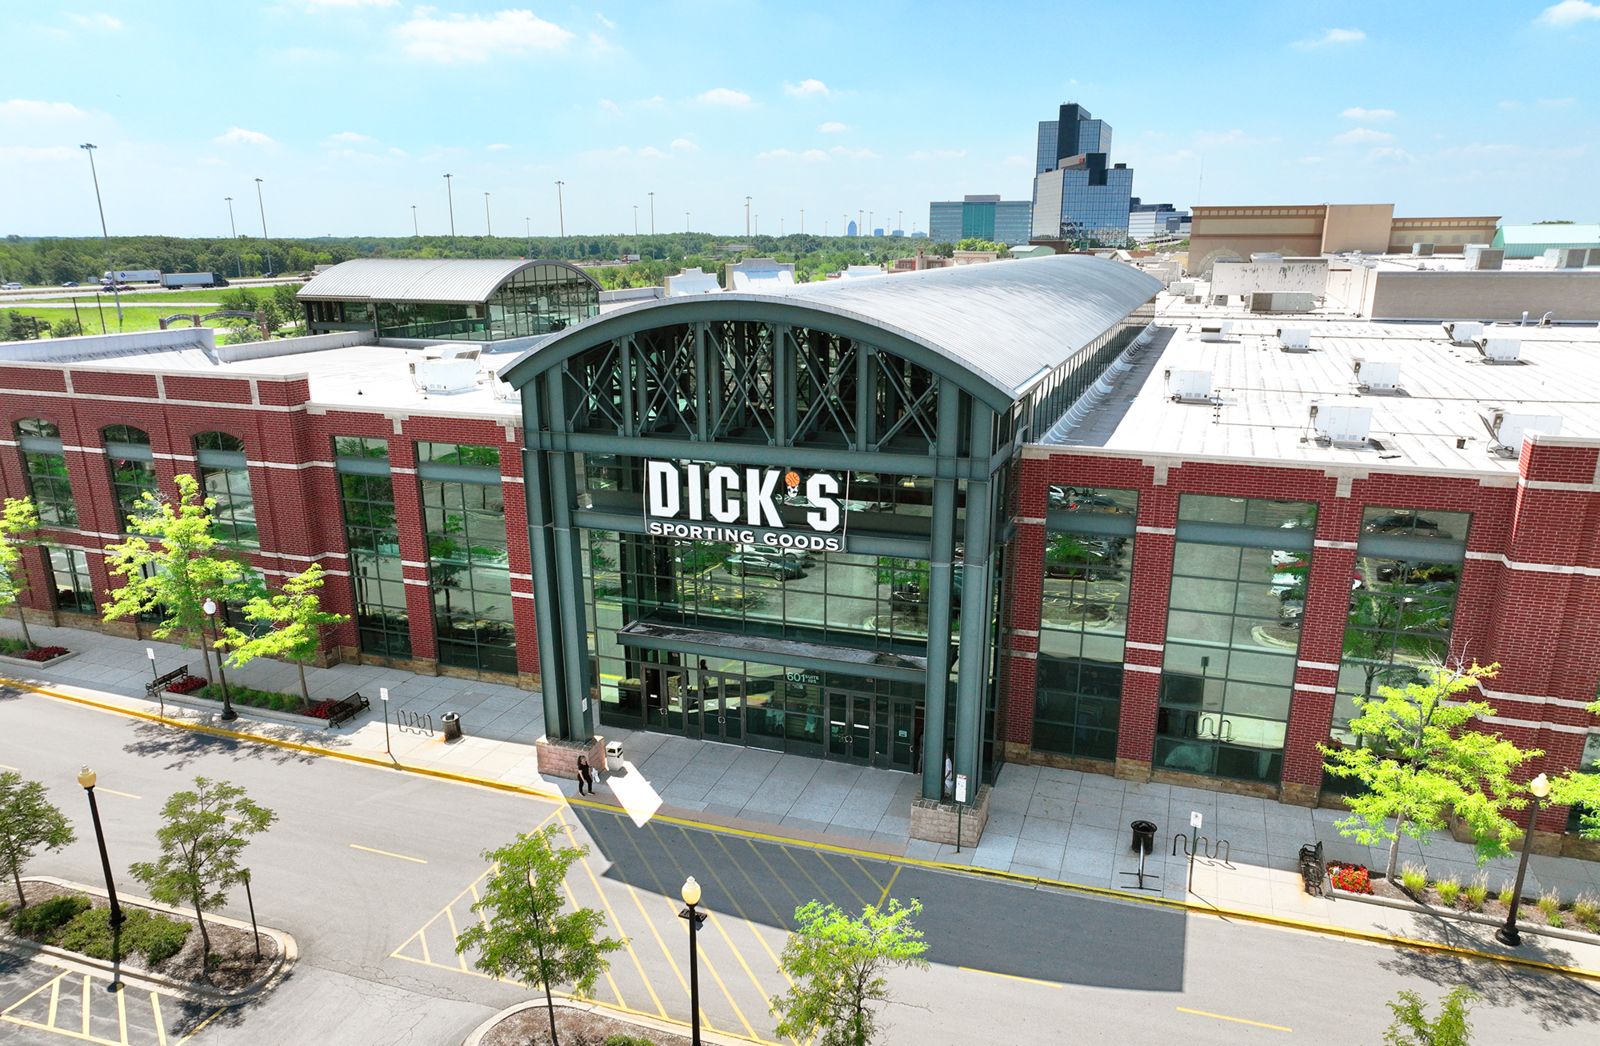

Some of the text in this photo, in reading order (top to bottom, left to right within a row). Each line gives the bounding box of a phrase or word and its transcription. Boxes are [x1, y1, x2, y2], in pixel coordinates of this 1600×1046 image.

[648, 461, 840, 532] DICK'S
[650, 522, 839, 551] SPORTING GOODS
[787, 672, 805, 682] 601
